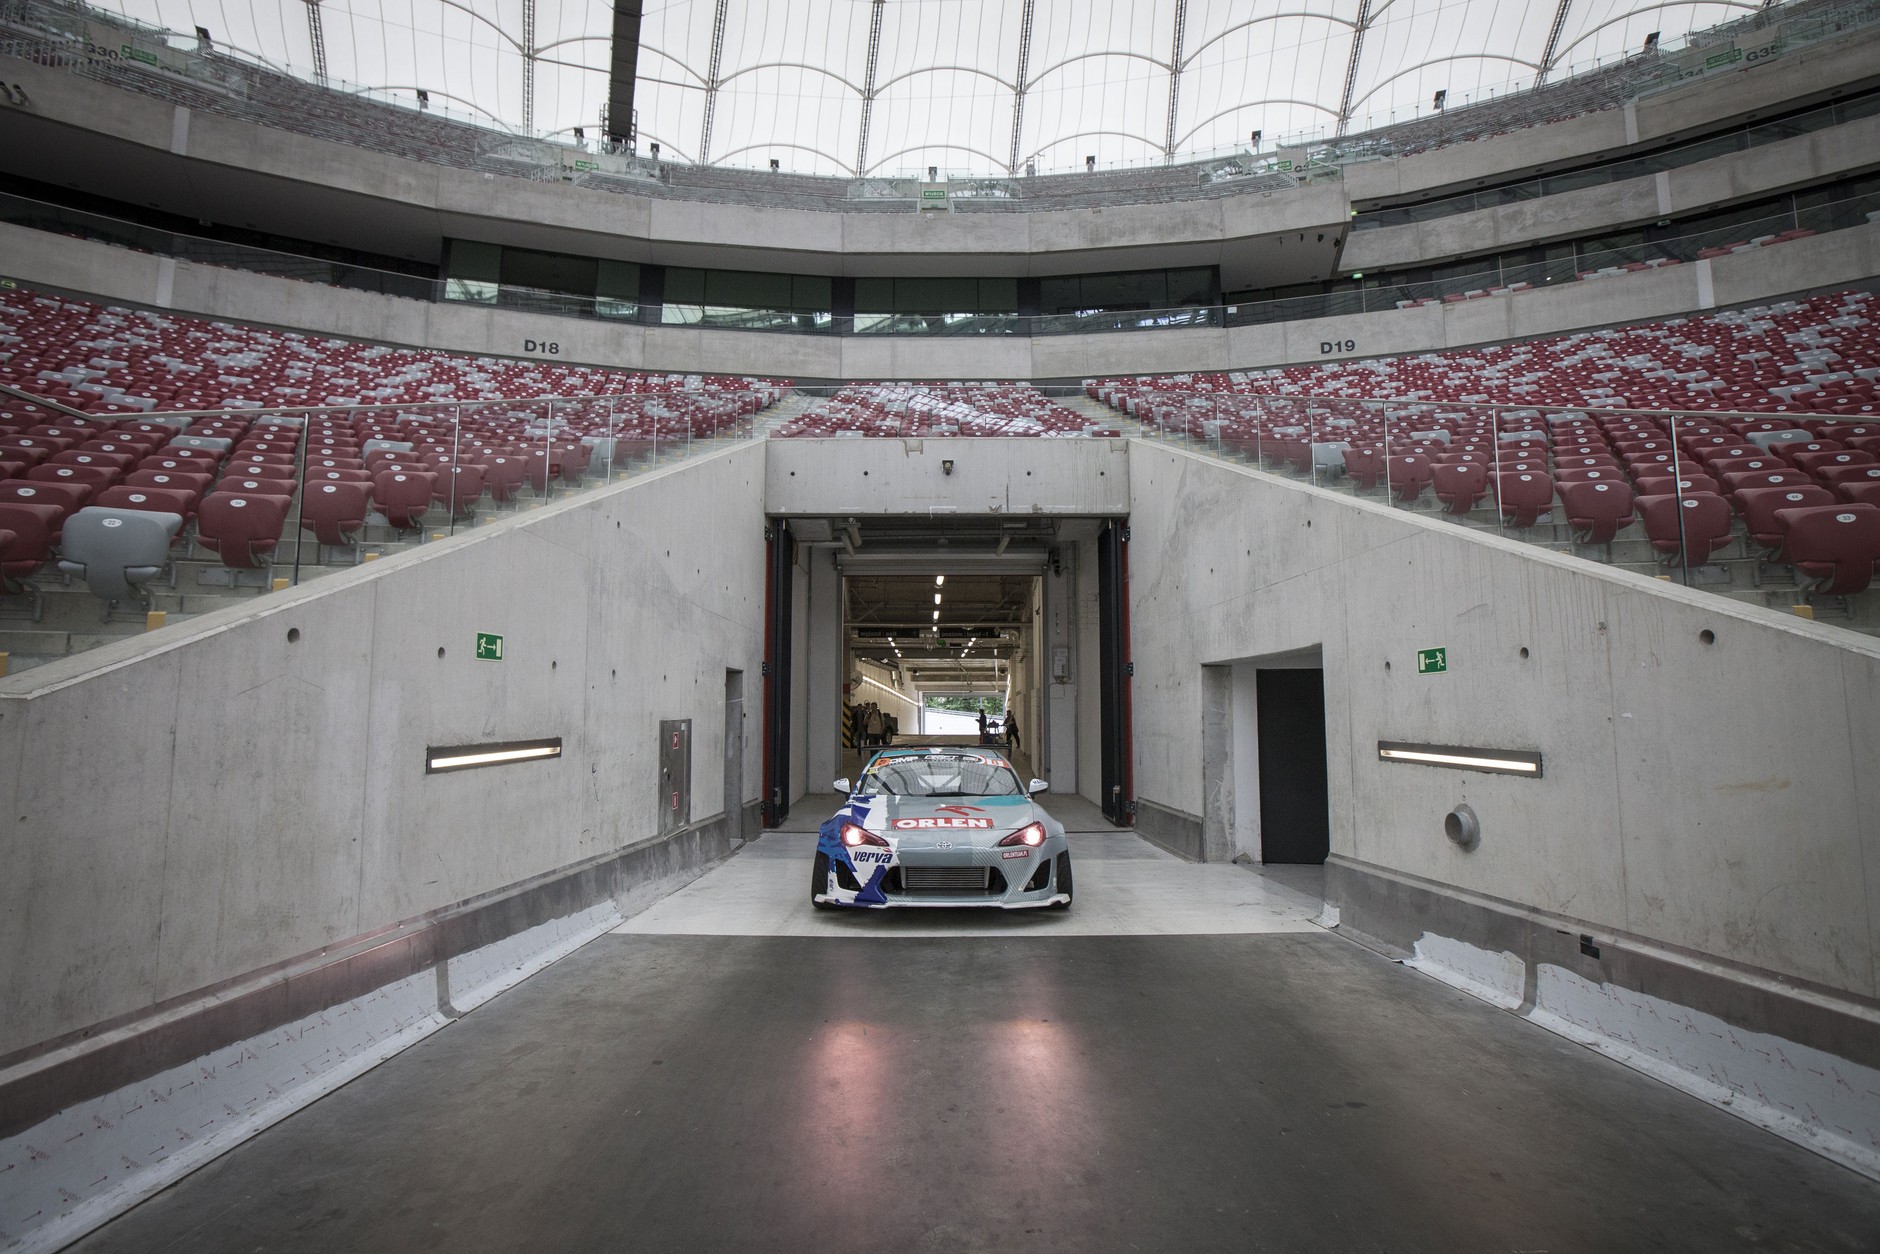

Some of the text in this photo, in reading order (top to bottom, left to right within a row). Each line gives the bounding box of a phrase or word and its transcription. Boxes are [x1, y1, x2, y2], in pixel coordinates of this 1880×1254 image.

[524, 339, 559, 354] D18
[1321, 340, 1355, 354] D19
[896, 819, 988, 829] ORLEN
[853, 851, 893, 864] verva
